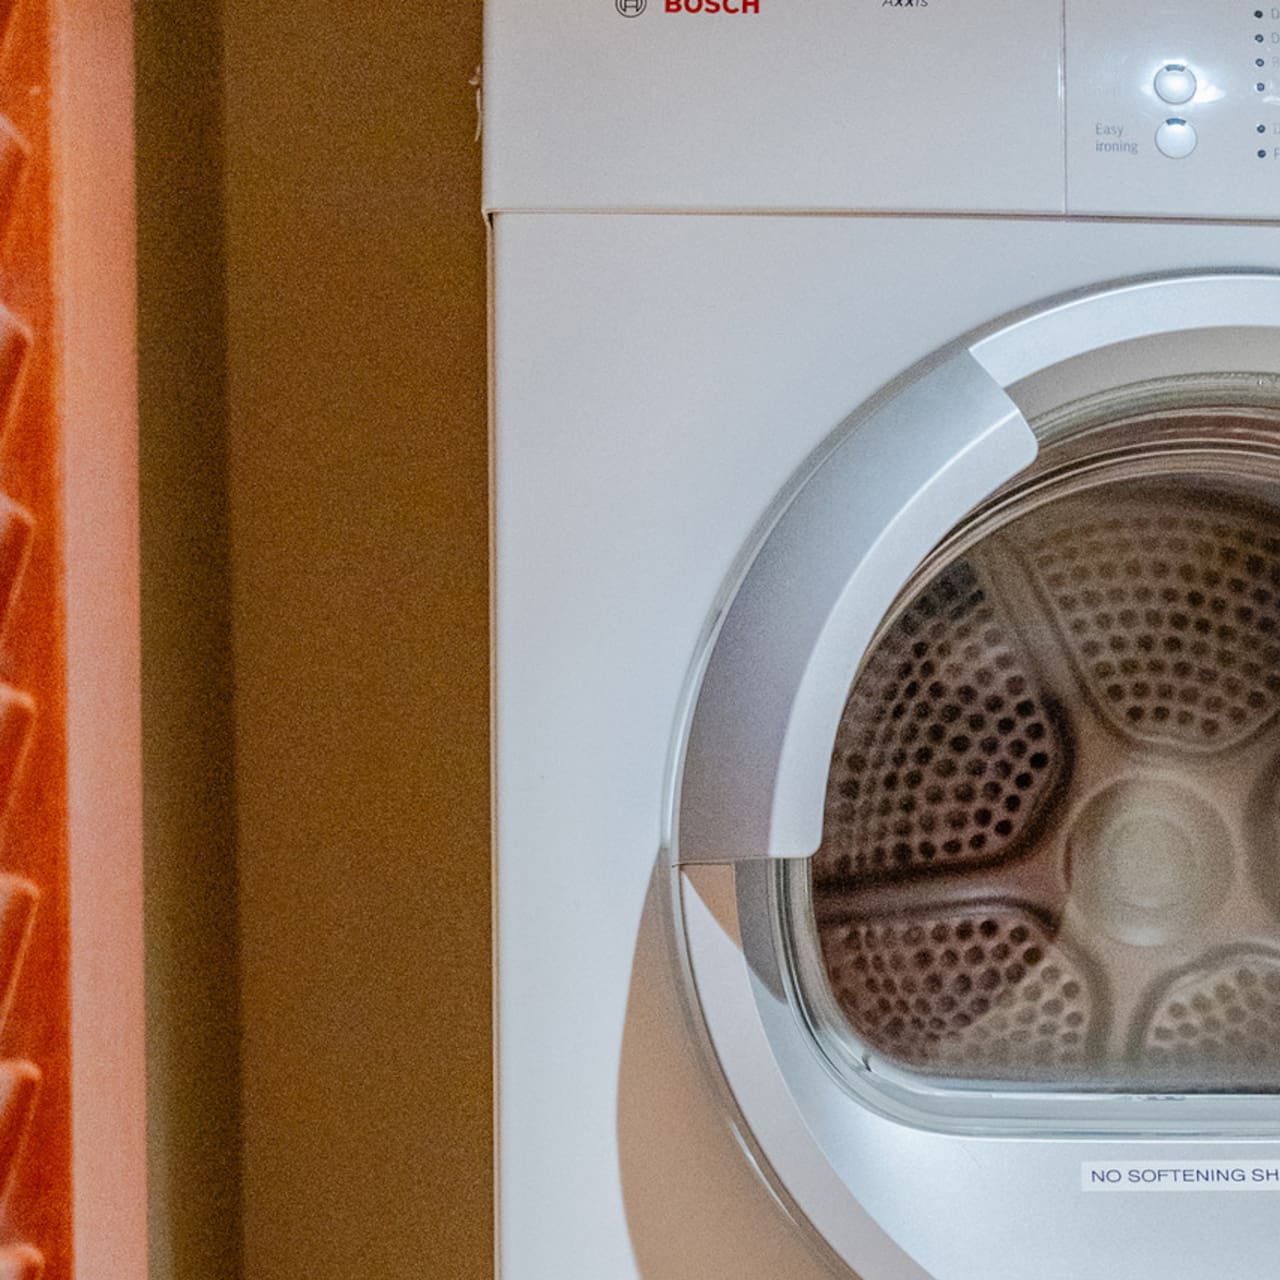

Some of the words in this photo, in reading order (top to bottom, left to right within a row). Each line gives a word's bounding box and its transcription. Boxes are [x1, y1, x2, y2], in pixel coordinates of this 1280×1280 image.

[664, 0, 760, 14] BOSCH
[1095, 122, 1124, 137] Easy
[1095, 140, 1138, 155] ironing
[1091, 1169, 1122, 1183] NO
[1128, 1168, 1246, 1183] SOFTENING
